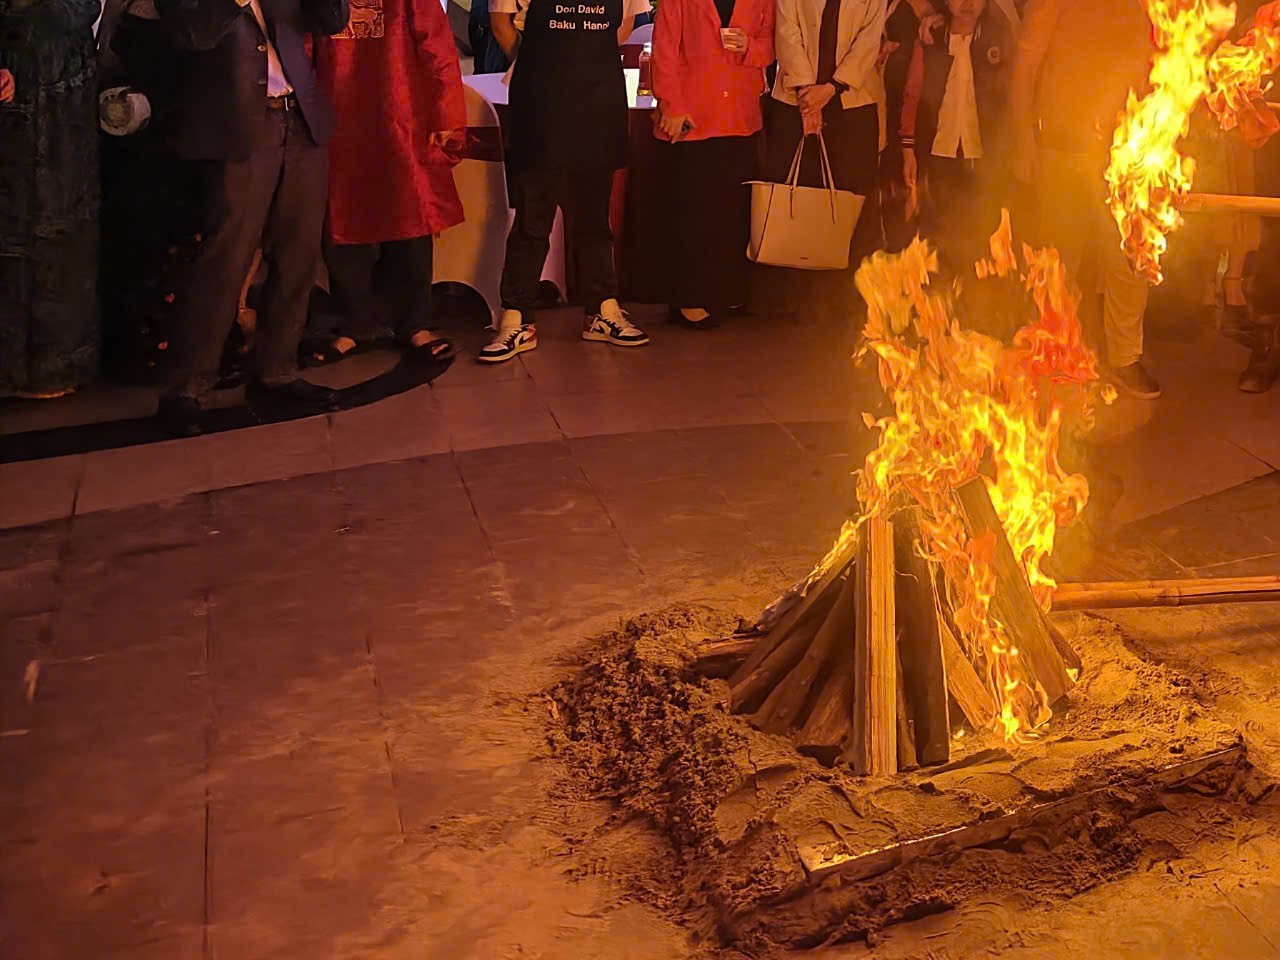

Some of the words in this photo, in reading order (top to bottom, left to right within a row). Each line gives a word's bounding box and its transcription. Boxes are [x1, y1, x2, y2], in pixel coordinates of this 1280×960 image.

[555, 4, 576, 14] Don
[578, 4, 605, 14] David
[549, 19, 576, 30] Baku
